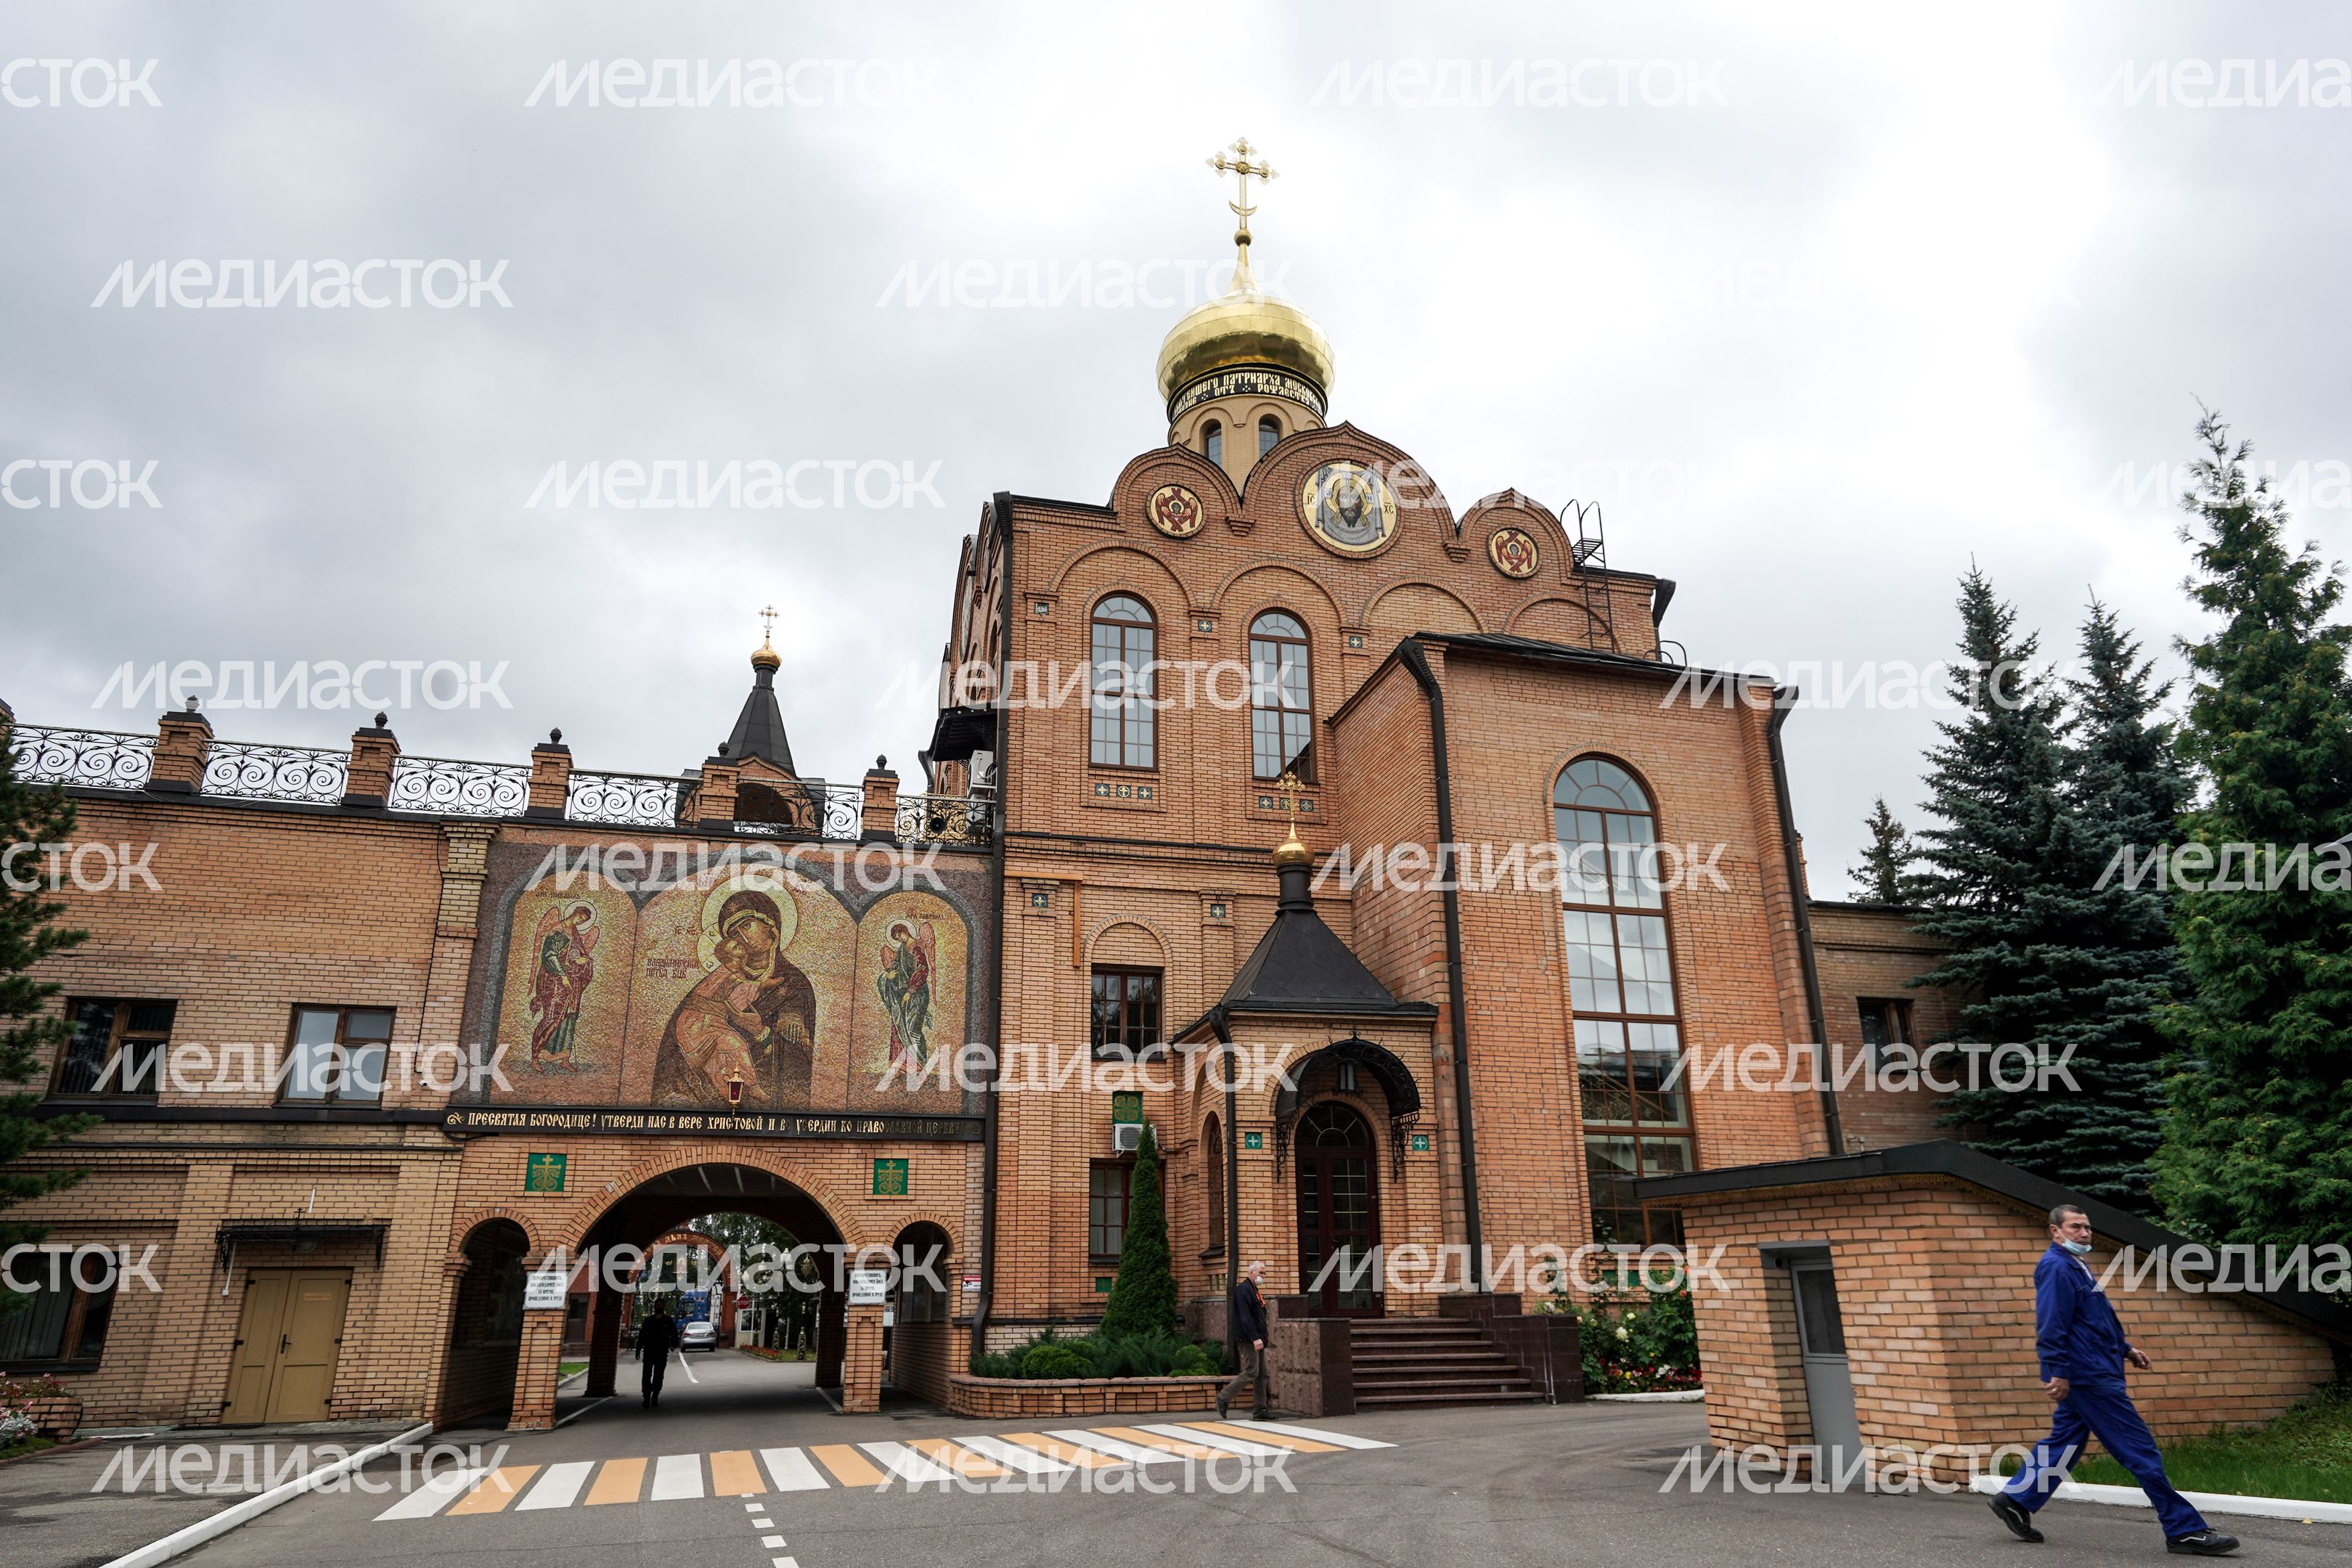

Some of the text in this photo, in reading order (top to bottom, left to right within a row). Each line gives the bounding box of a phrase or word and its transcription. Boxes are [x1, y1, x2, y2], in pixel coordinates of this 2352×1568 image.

[467, 1112, 526, 1126] ПРЕСВЯТАЯ
[601, 1114, 644, 1130] УТВЕРДИ
[648, 1116, 666, 1129] НАС
[669, 1116, 675, 1129] В
[678, 1116, 703, 1130] ВЕРЕ
[707, 1116, 763, 1131] ХРИСТОВОЙ
[768, 1118, 775, 1131] И
[841, 1120, 852, 1132] КО
